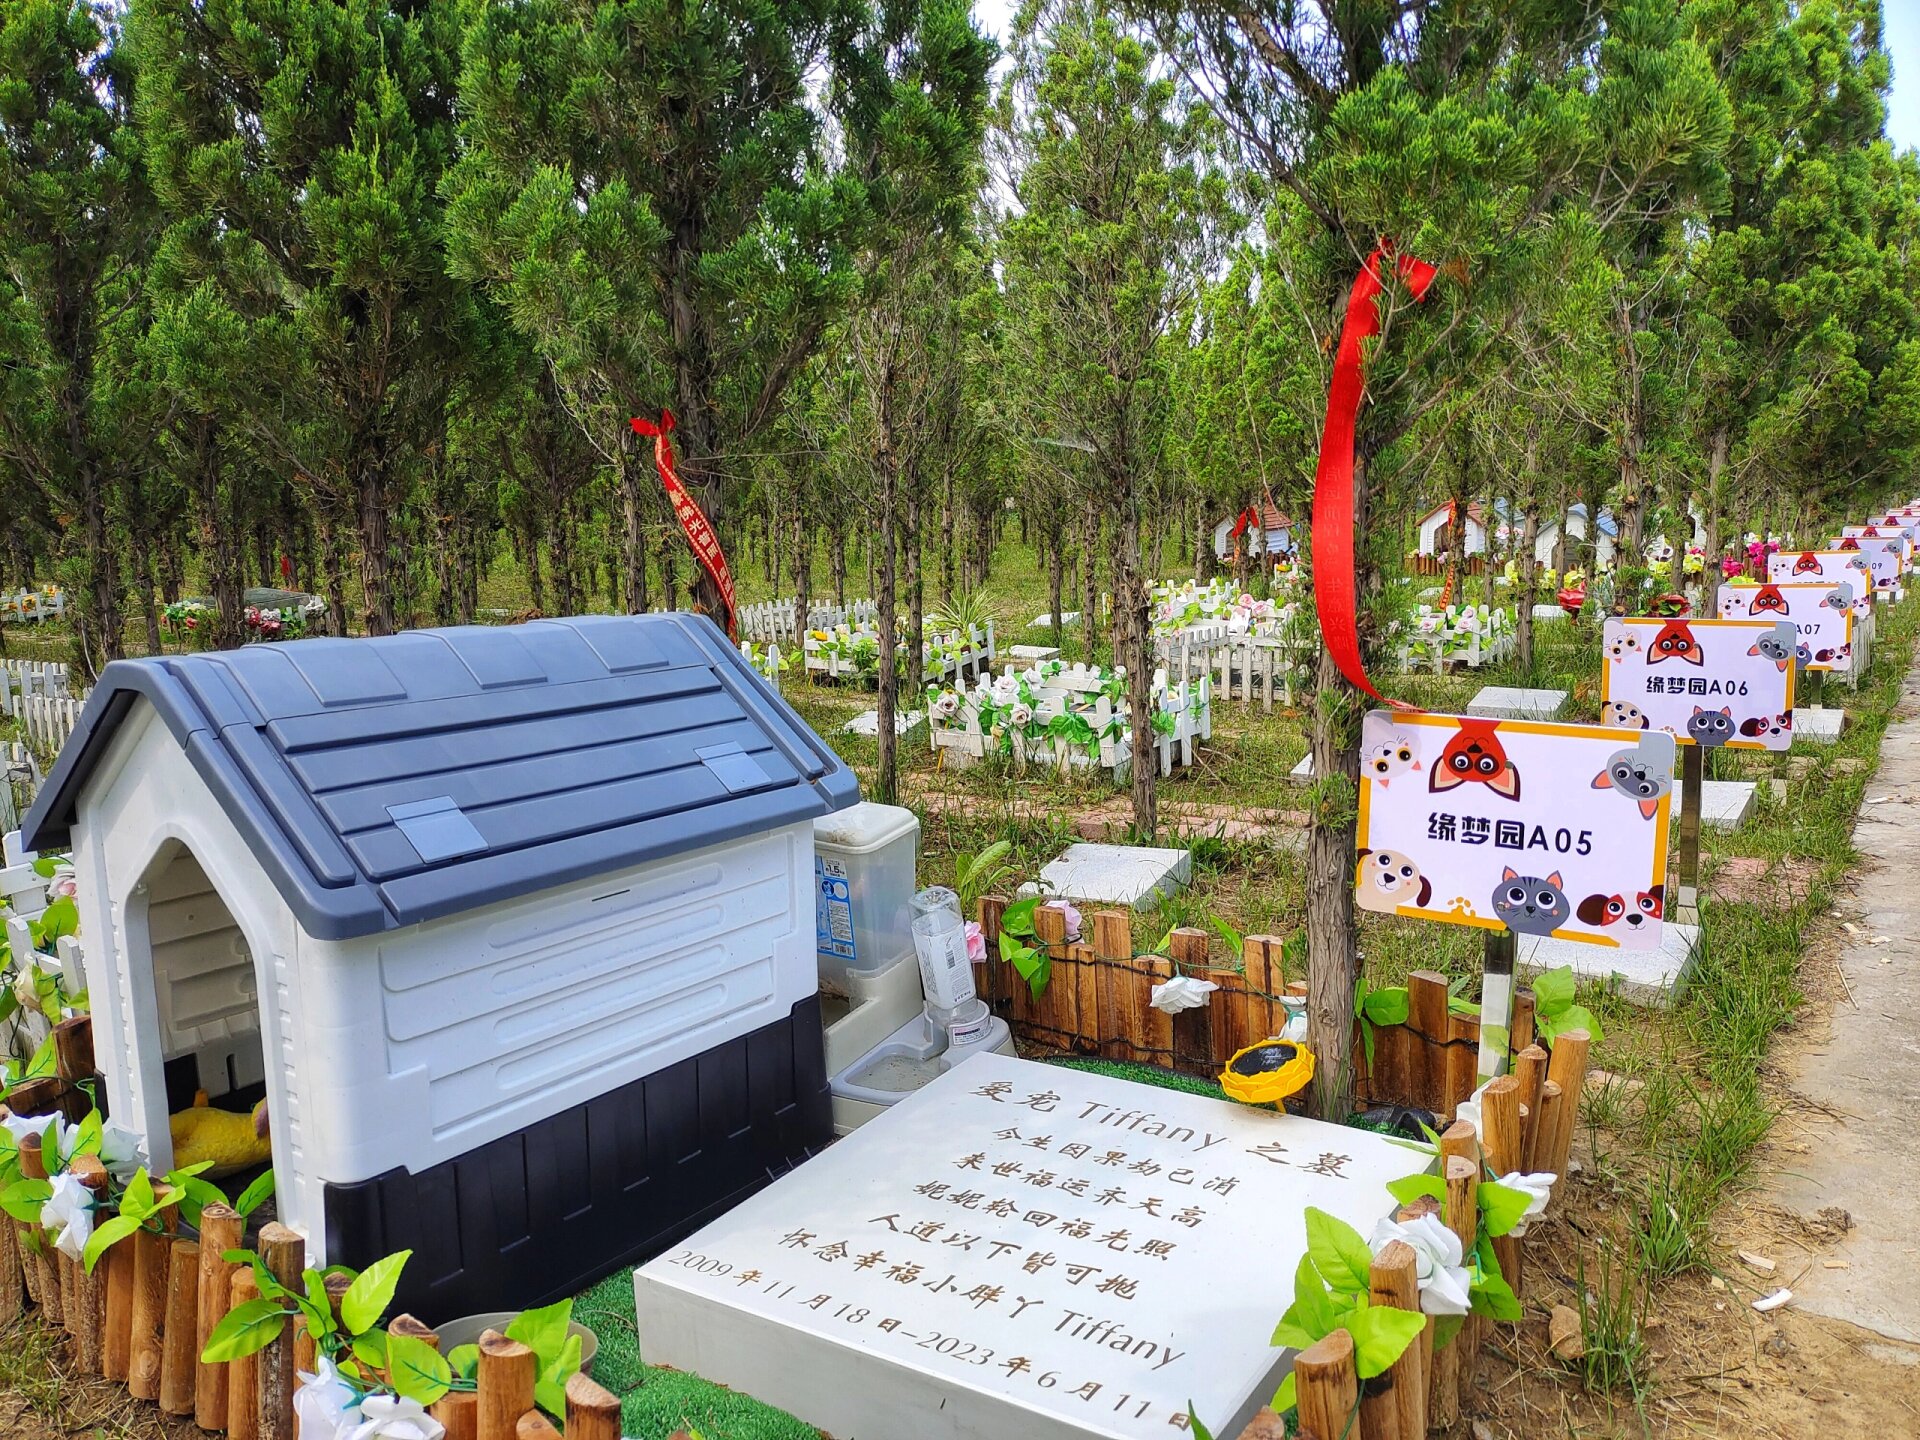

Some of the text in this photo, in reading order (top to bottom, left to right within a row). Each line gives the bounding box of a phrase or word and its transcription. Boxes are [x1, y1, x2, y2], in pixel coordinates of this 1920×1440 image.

[678, 505, 719, 560] 佛光普照
[1645, 675, 1749, 697] 缘梦园A06
[1427, 811, 1593, 856] 缘梦园A05
[967, 1081, 1353, 1180] 爱宠 Tiffany 之墓
[912, 1180, 1178, 1261] 妮妮轮回福光照
[952, 1152, 1207, 1228] 来世福运齐天高
[868, 1213, 1138, 1300] 人道以下皆可抛
[1050, 1309, 1187, 1371] Tiffany
